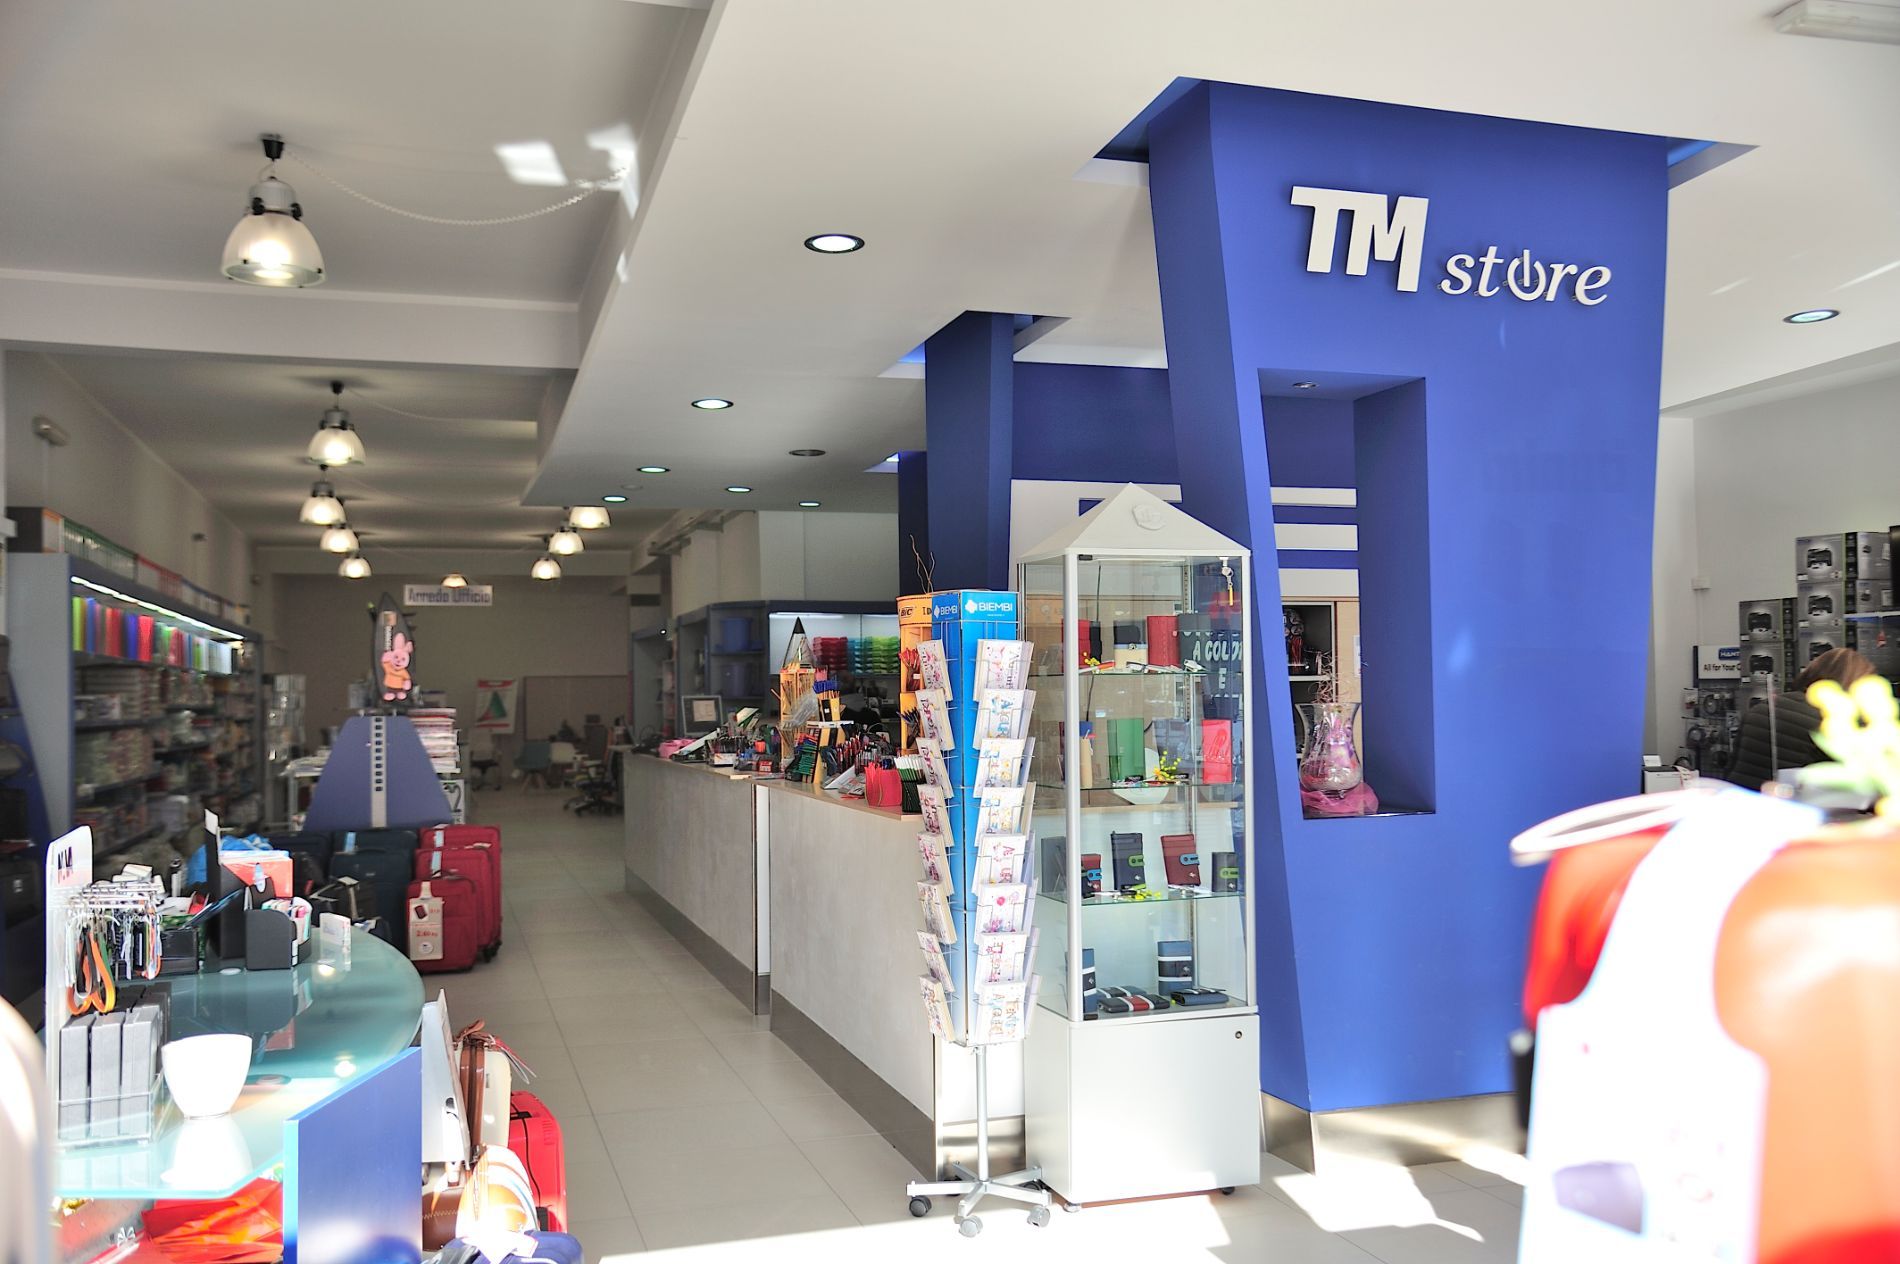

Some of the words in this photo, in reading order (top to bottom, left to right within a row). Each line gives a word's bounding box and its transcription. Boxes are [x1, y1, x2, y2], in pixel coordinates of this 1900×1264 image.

[1291, 186, 1429, 293] TM
[1440, 246, 1612, 306] store
[408, 588, 449, 603] Arredo
[451, 587, 491, 603] Ufficio
[940, 605, 958, 616] BIEMBI
[979, 602, 1012, 612] BIEMBI
